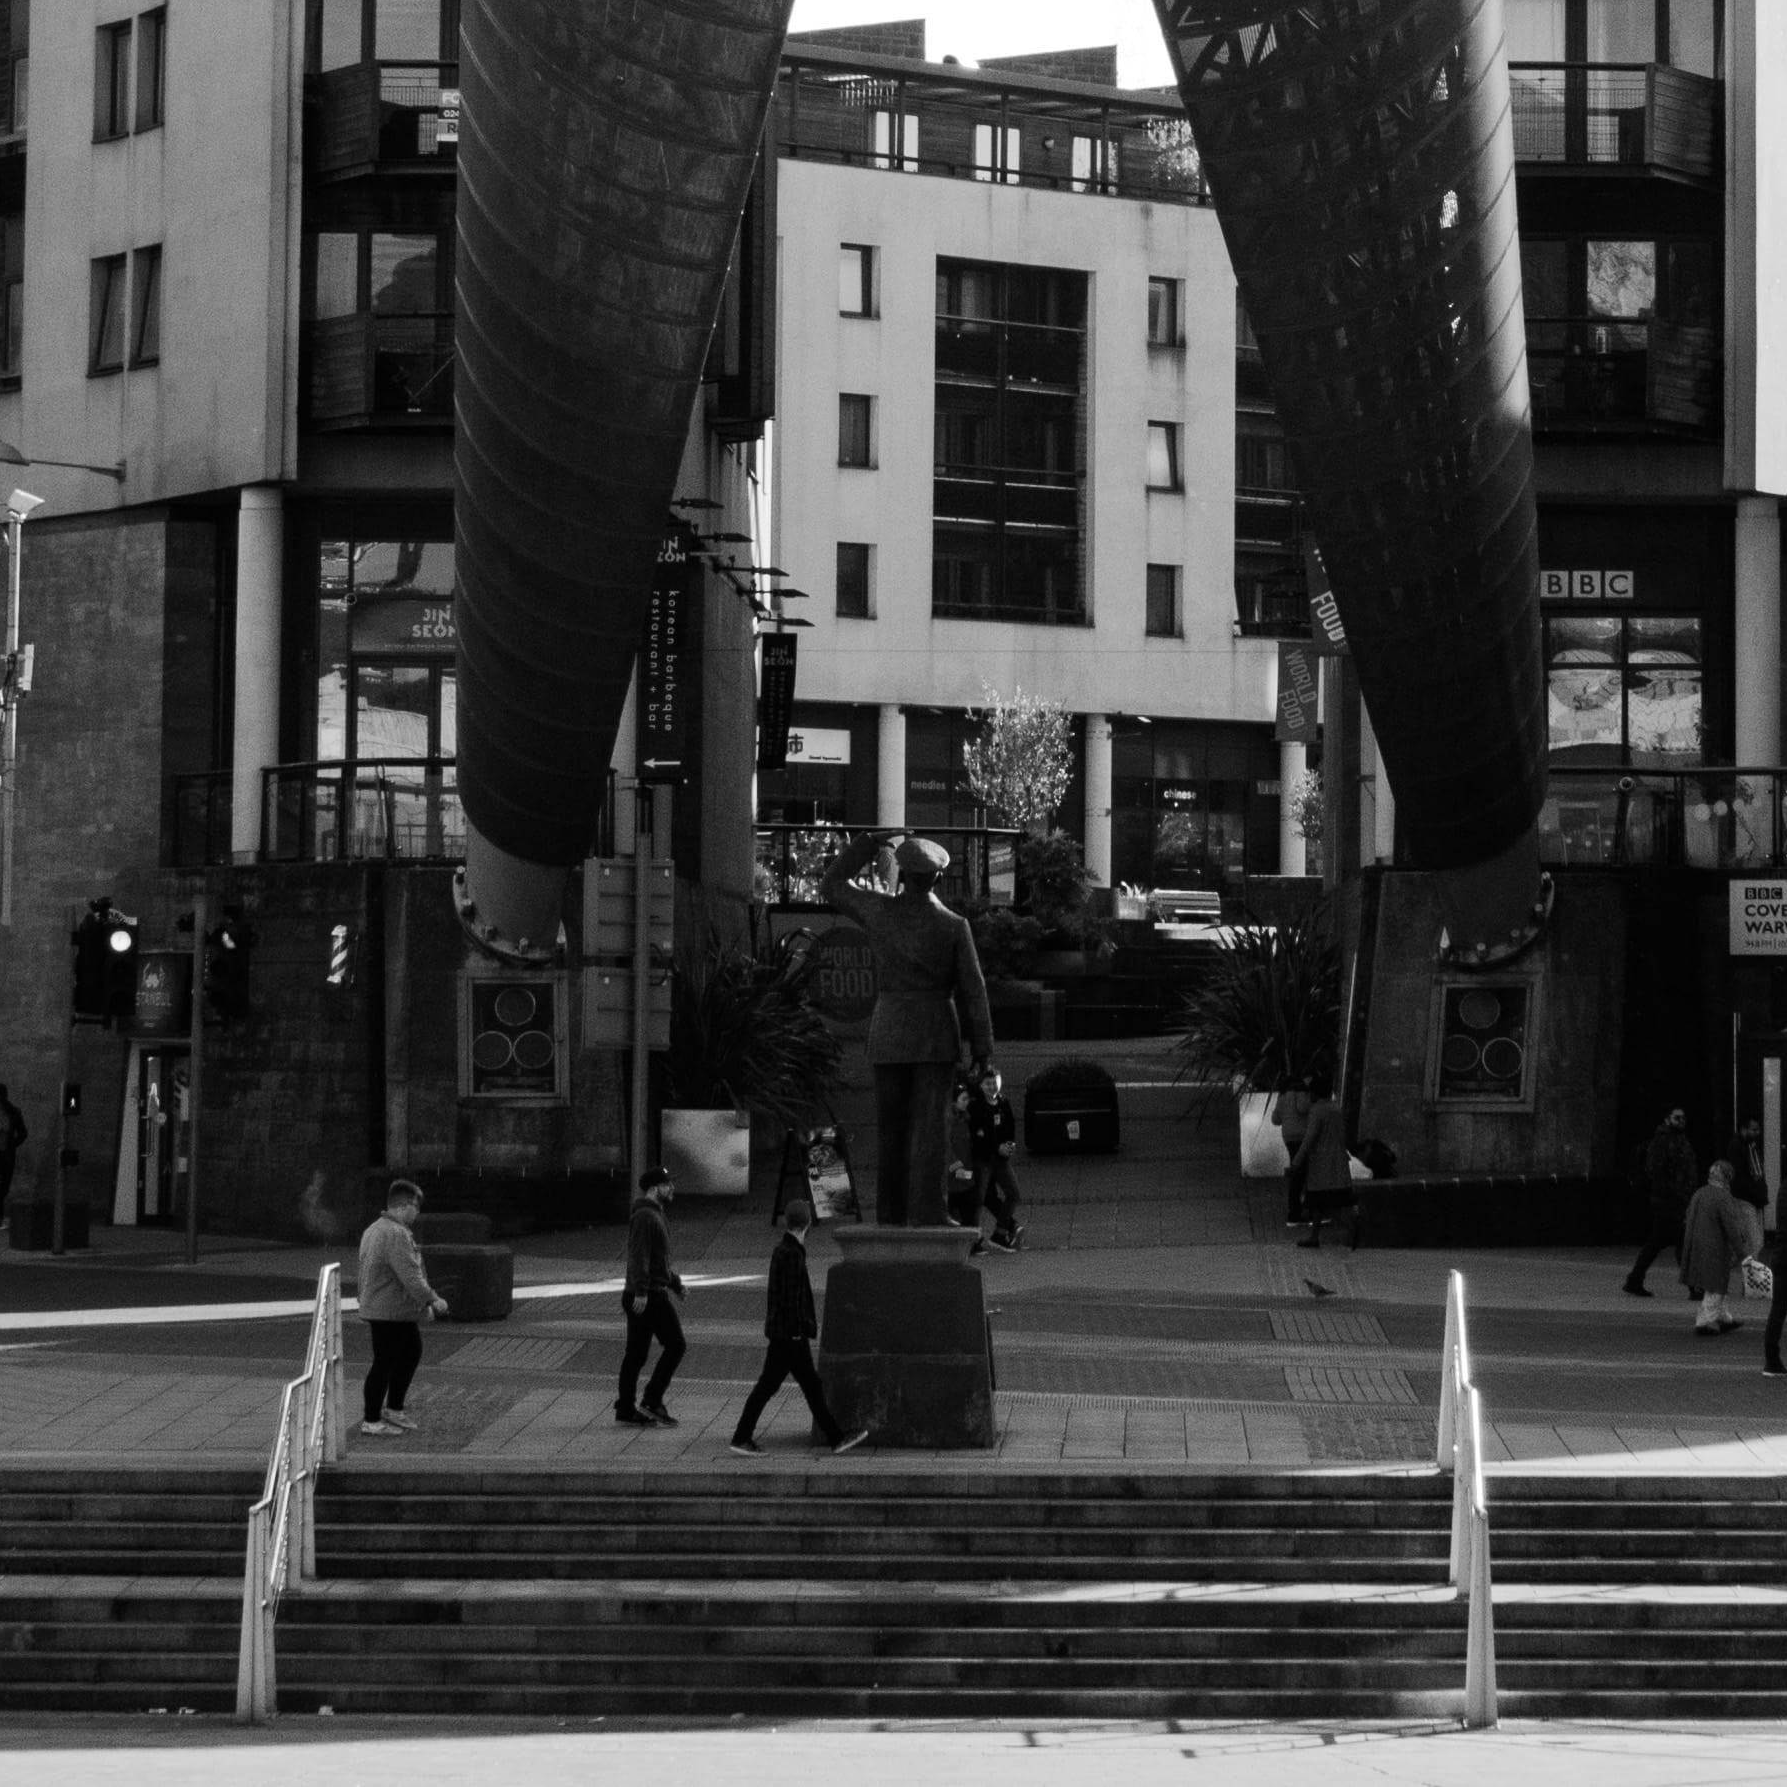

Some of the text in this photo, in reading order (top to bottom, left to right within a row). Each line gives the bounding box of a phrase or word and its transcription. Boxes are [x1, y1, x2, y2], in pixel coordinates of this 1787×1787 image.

[1543, 572, 1631, 596] BBC
[422, 604, 452, 622] JIN
[649, 590, 661, 676] restaurant
[662, 589, 681, 732] korean barbeque
[1284, 648, 1318, 705] WORLD
[648, 703, 660, 730] bar
[1280, 688, 1307, 730] FOOD
[1163, 788, 1198, 801] chinese
[1745, 888, 1783, 900] BBC
[819, 946, 872, 967] WORLD
[819, 968, 874, 998] FOOD
